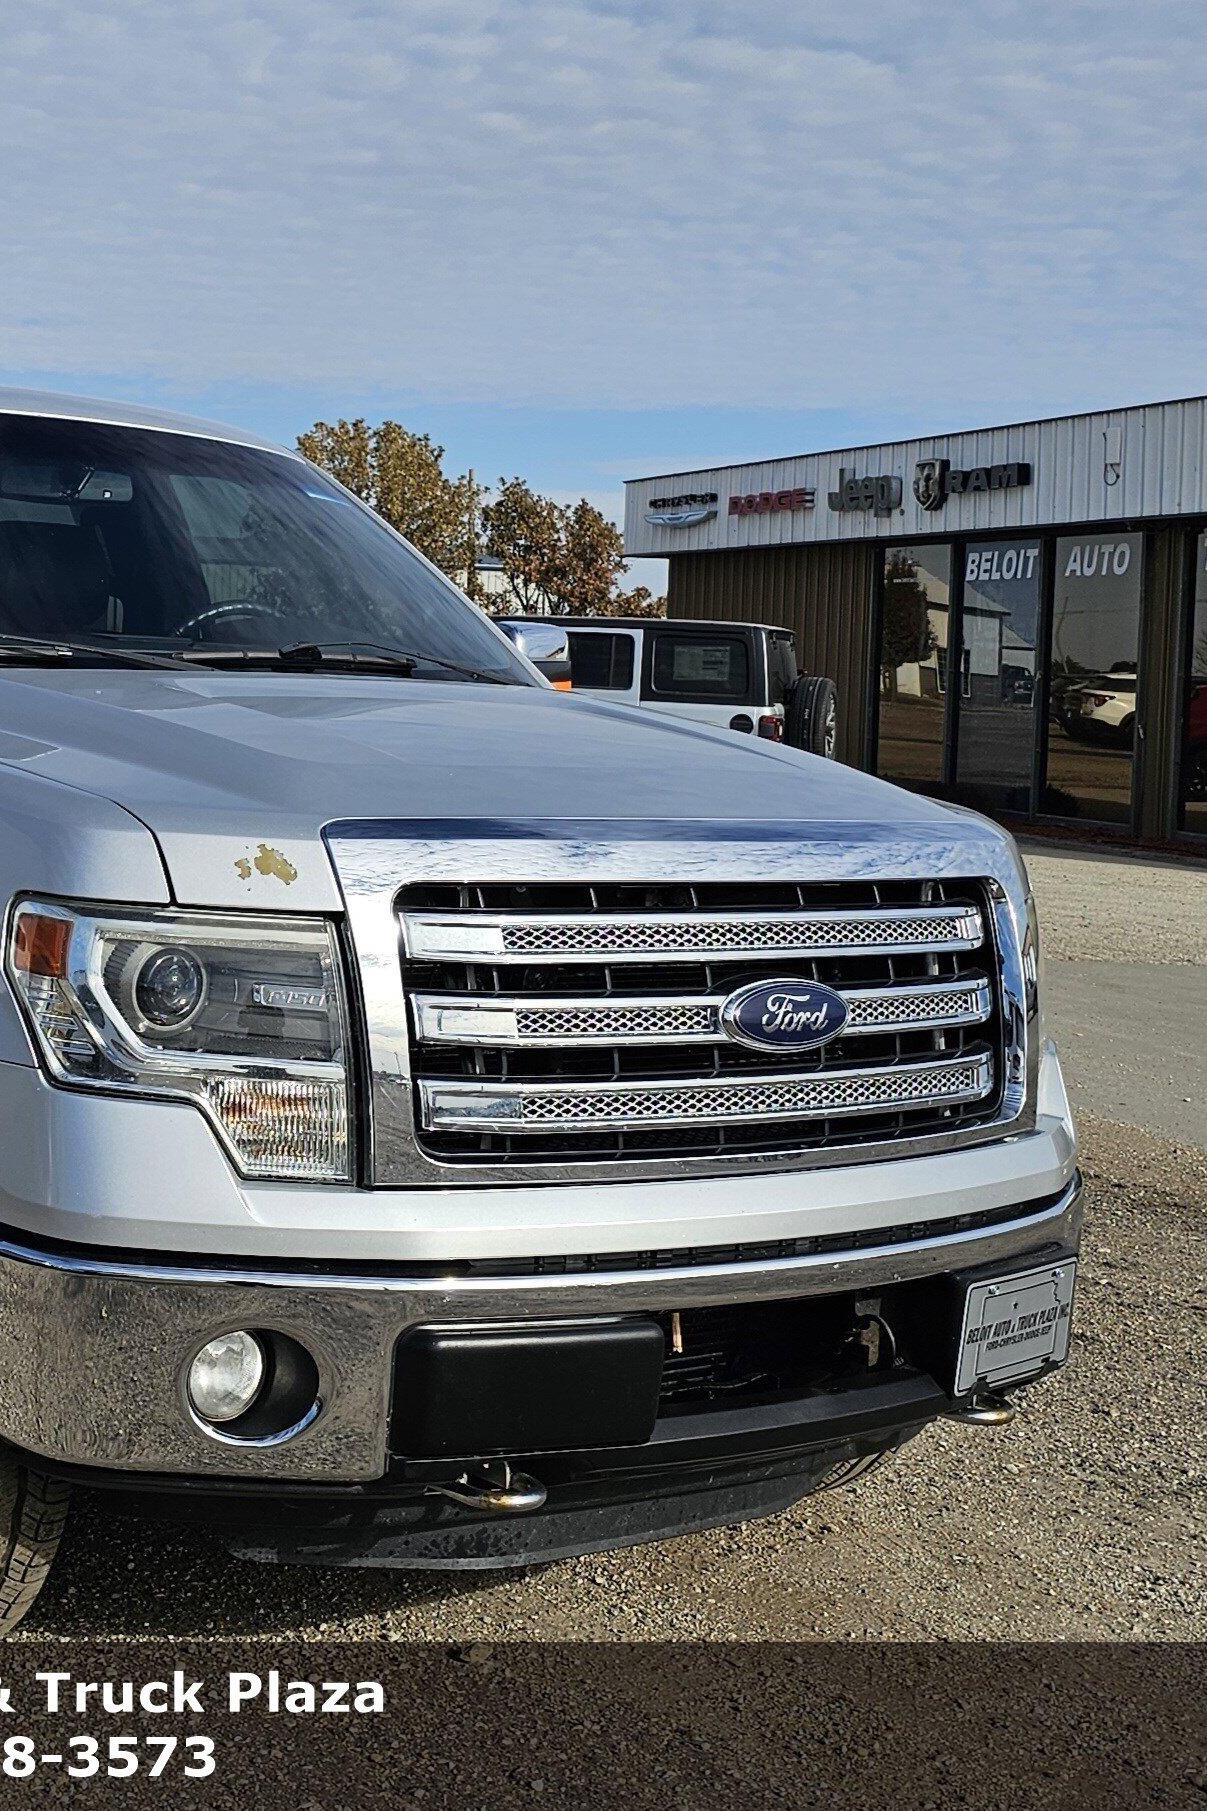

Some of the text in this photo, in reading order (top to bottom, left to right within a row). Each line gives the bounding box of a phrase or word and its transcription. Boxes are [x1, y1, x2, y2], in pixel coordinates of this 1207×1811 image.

[827, 467, 903, 518] Jeep
[945, 462, 1030, 494] RAM
[728, 487, 808, 516] DODGE
[965, 543, 1131, 582] BELOIT AUTO
[761, 993, 829, 1034] Ford
